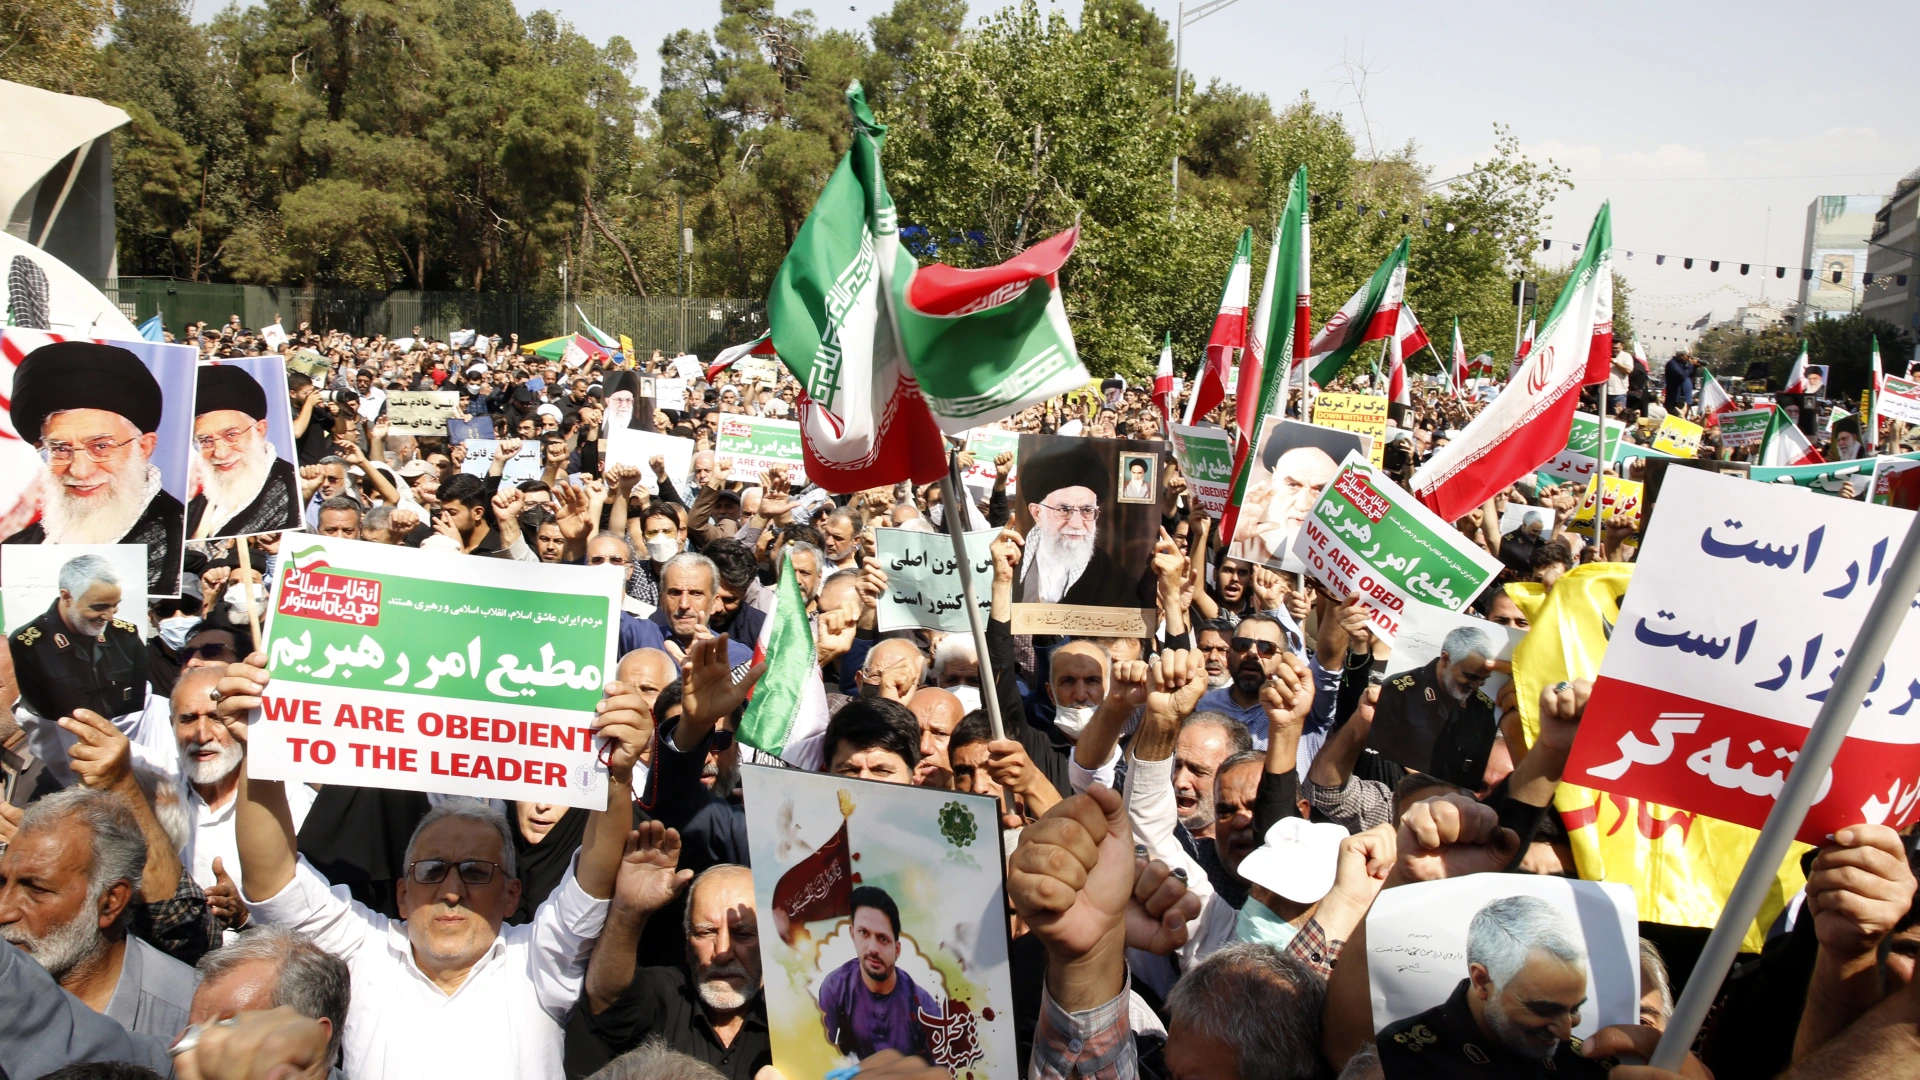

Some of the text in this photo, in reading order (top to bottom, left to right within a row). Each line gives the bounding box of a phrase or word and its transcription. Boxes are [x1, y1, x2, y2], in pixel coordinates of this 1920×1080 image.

[391, 398, 408, 407] ملت
[410, 397, 431, 409] خادم
[1317, 412, 1342, 420] DOWN
[737, 457, 756, 467] ARE
[1199, 485, 1228, 499] OBEDIE
[1205, 500, 1225, 513] LEAD
[1700, 518, 1826, 574] است
[890, 548, 928, 571] اصلی
[1373, 553, 1421, 576] امر
[1306, 521, 1404, 616] WE ARE OBED
[1307, 546, 1324, 570] TO
[1326, 567, 1352, 598] THE
[893, 591, 922, 607] است
[1405, 572, 1462, 611] مطیع
[388, 597, 413, 607] هستند
[413, 601, 443, 612] رهبری
[443, 604, 450, 614] و
[927, 593, 964, 615] کشور
[450, 604, 480, 616] اسلامی
[480, 607, 507, 618] انقلاب
[533, 612, 557, 624] عاشق
[557, 614, 581, 627] ایران
[581, 617, 603, 628] مردم
[1634, 609, 1758, 665] است
[269, 629, 602, 698] مطیع امر رهبریم
[261, 695, 598, 753] WE ARE OBEDIENT
[1586, 712, 1706, 780] گر
[286, 737, 568, 788] TO THE LEADER
[1686, 737, 1833, 807] تنه
